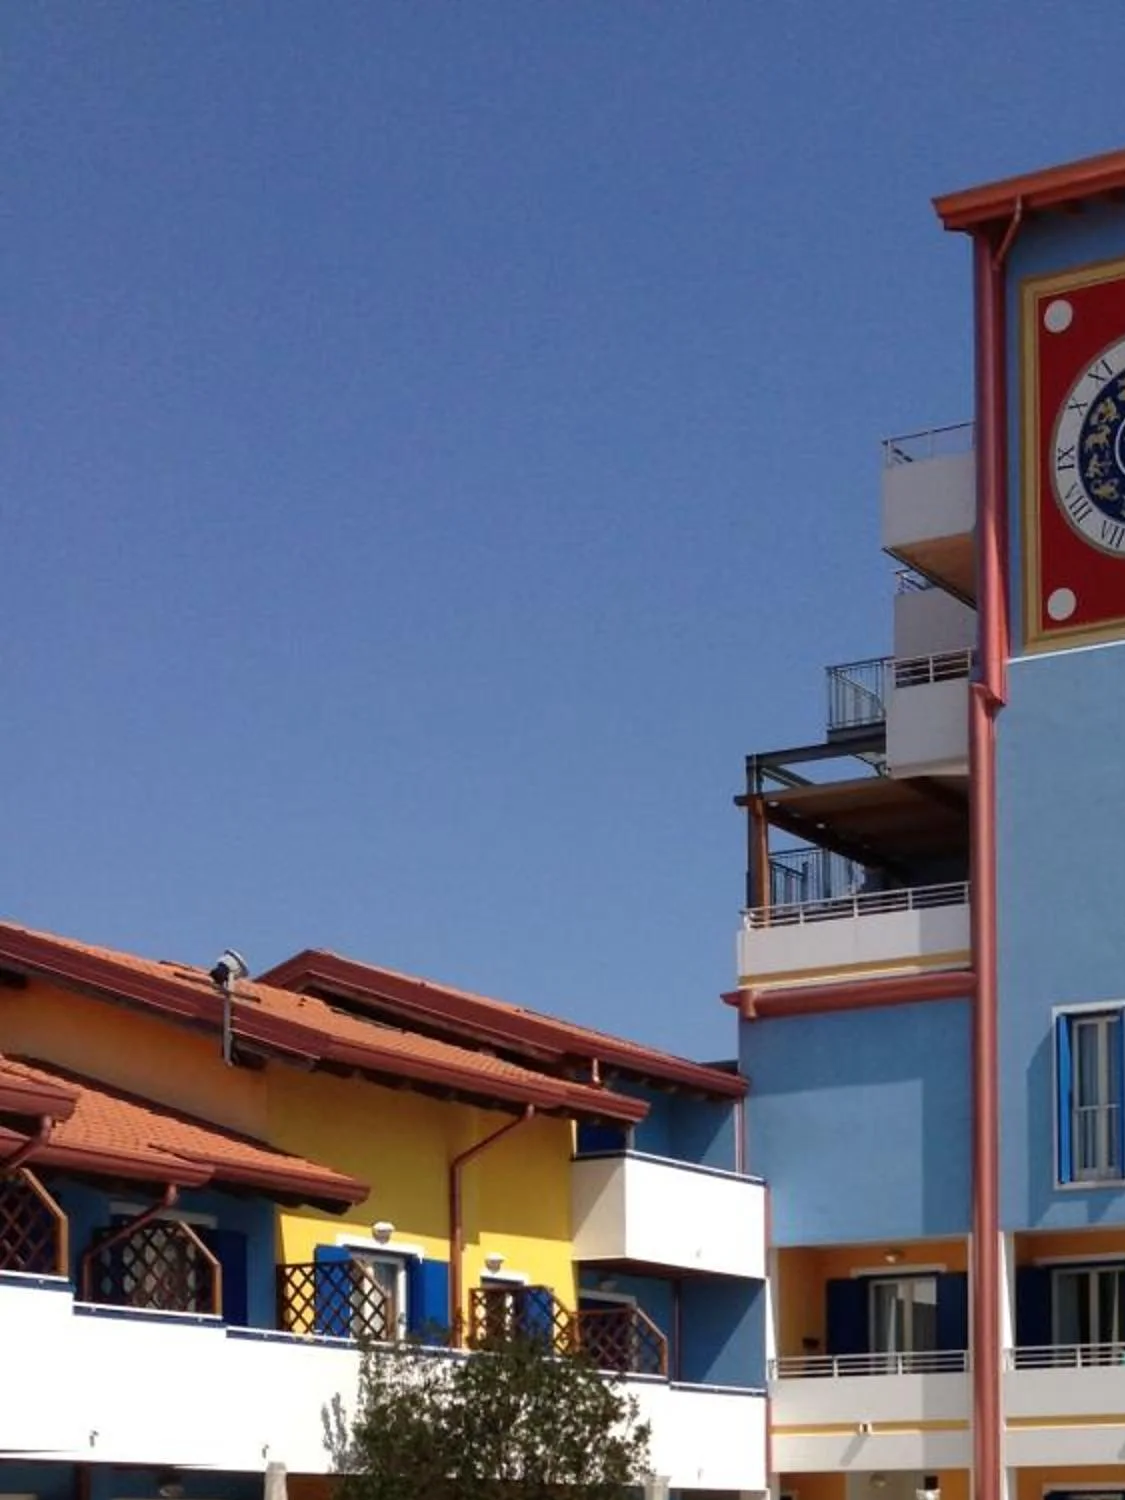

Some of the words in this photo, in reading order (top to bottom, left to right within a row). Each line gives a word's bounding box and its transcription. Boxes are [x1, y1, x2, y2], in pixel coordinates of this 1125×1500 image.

[1088, 360, 1114, 384] XI
[1068, 398, 1089, 416] X
[1058, 445, 1076, 471] IX
[1100, 520, 1125, 548] VII
